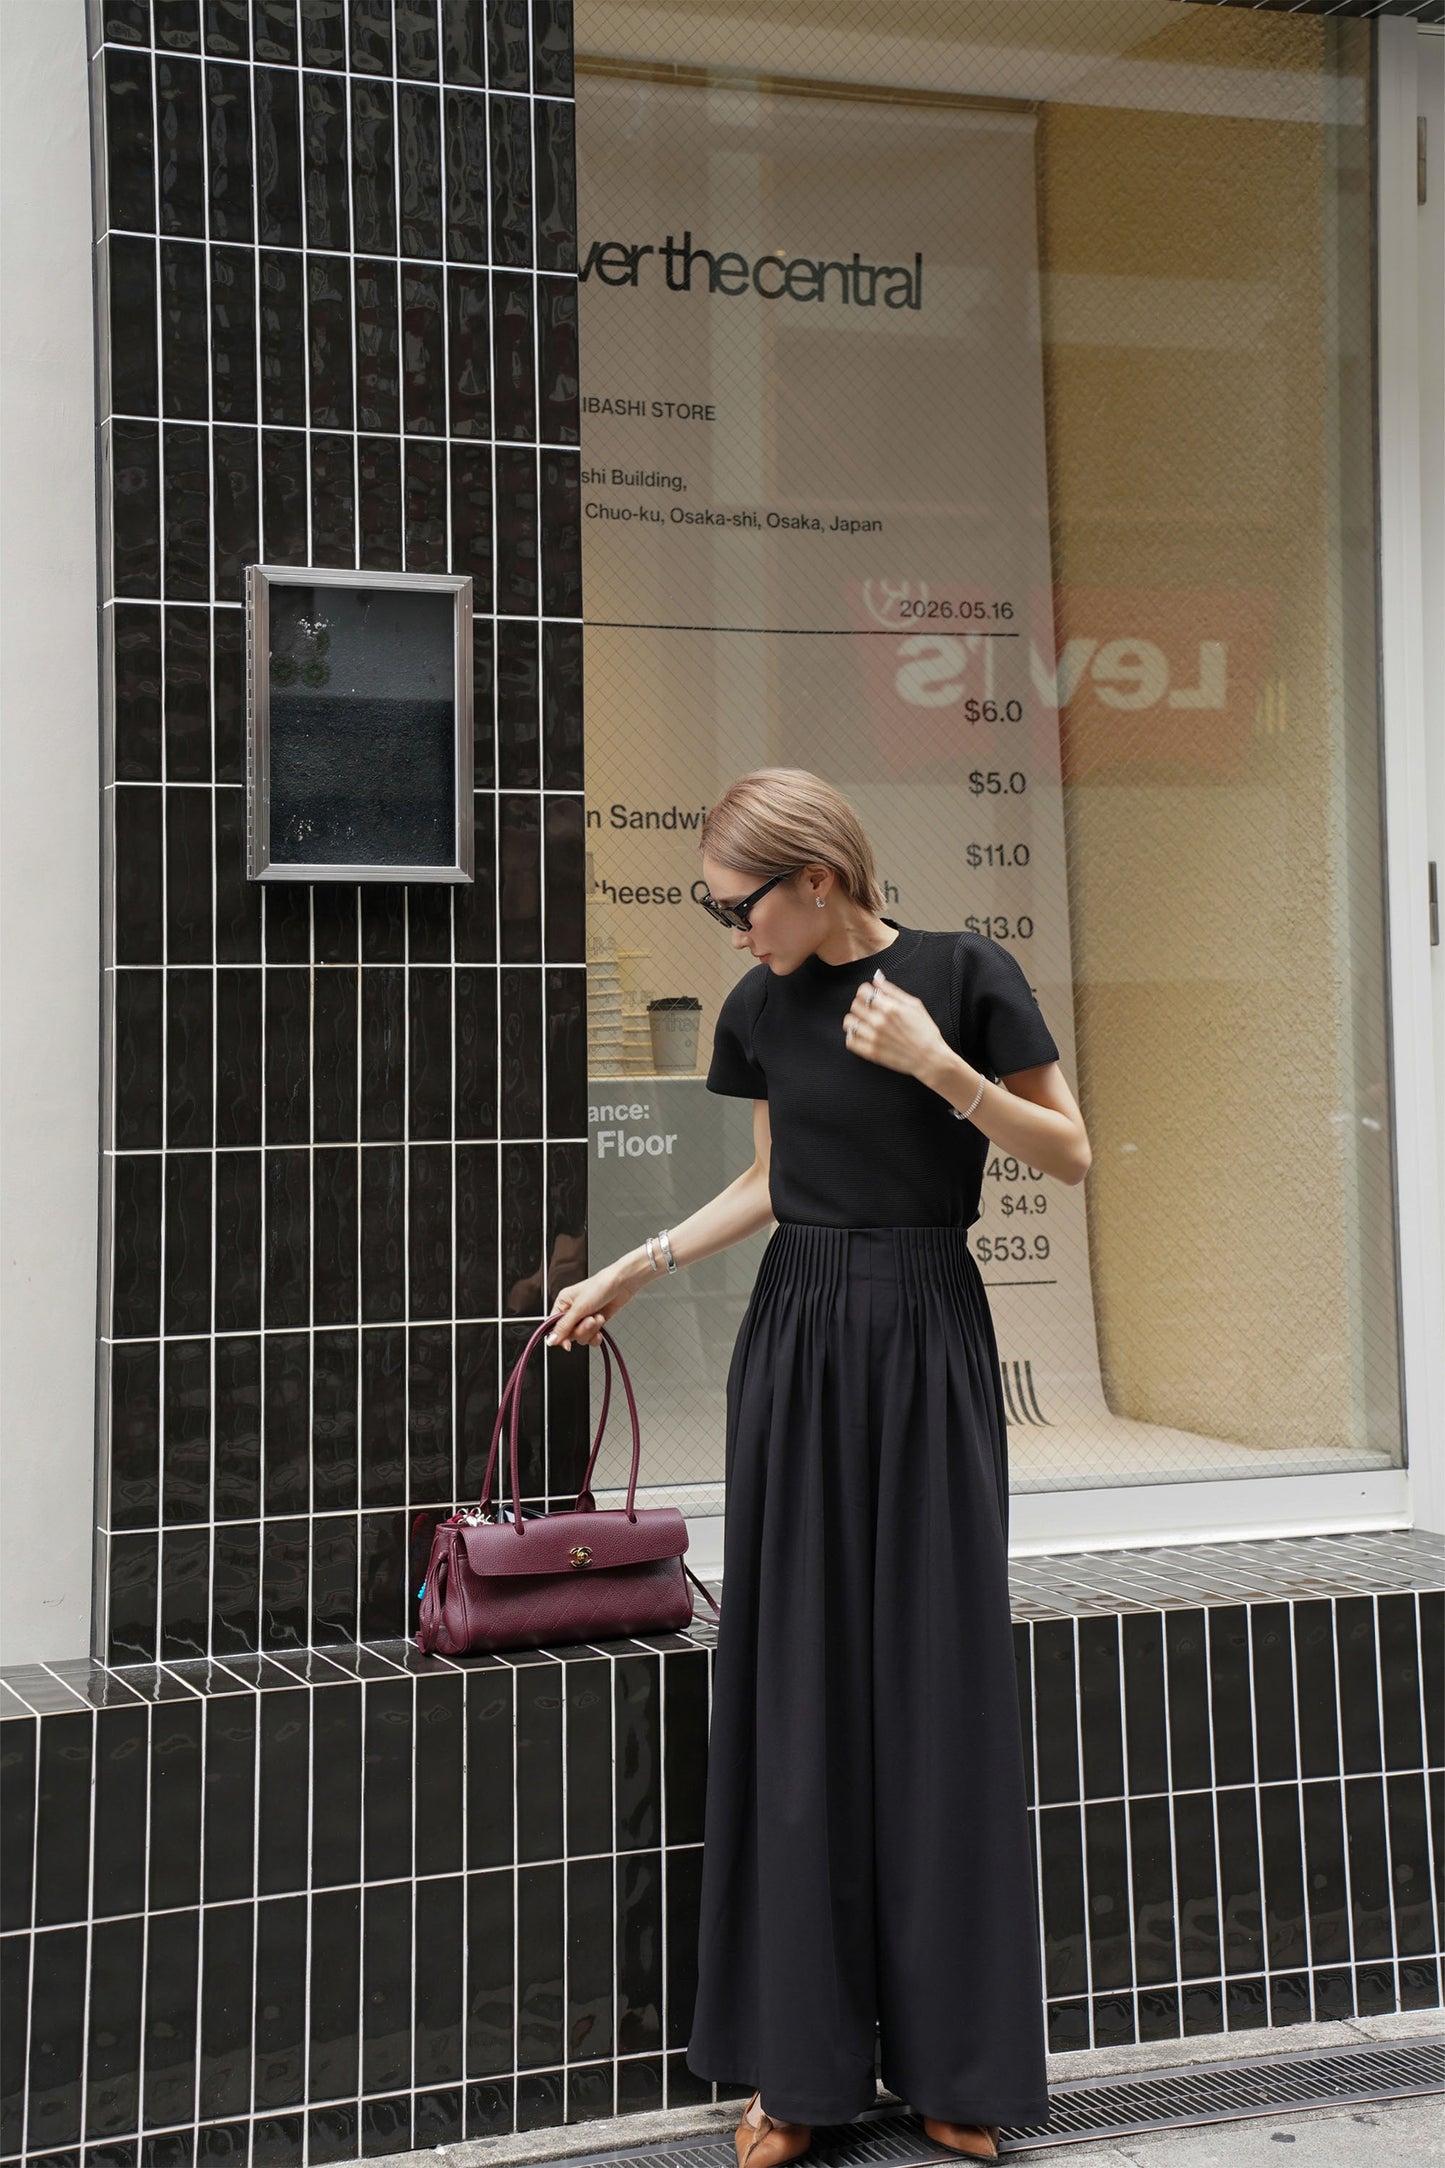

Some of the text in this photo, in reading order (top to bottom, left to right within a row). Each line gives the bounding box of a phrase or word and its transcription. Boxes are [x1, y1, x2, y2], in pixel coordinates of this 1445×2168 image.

[651, 401, 717, 421] STORE
[611, 469, 688, 492] Building,
[585, 502, 883, 534] Chuo-ku, Osaka-shi, Osaka, Japan
[899, 599, 1015, 620] 2026.05.16
[964, 698, 1023, 726] $6.0
[968, 769, 1027, 797] $5.0
[966, 842, 1031, 869] $11.0
[964, 914, 1034, 940] $13.0
[597, 1130, 678, 1158] Floor
[1001, 1194, 1047, 1218] $4.9
[976, 1235, 1050, 1265] $53.9
